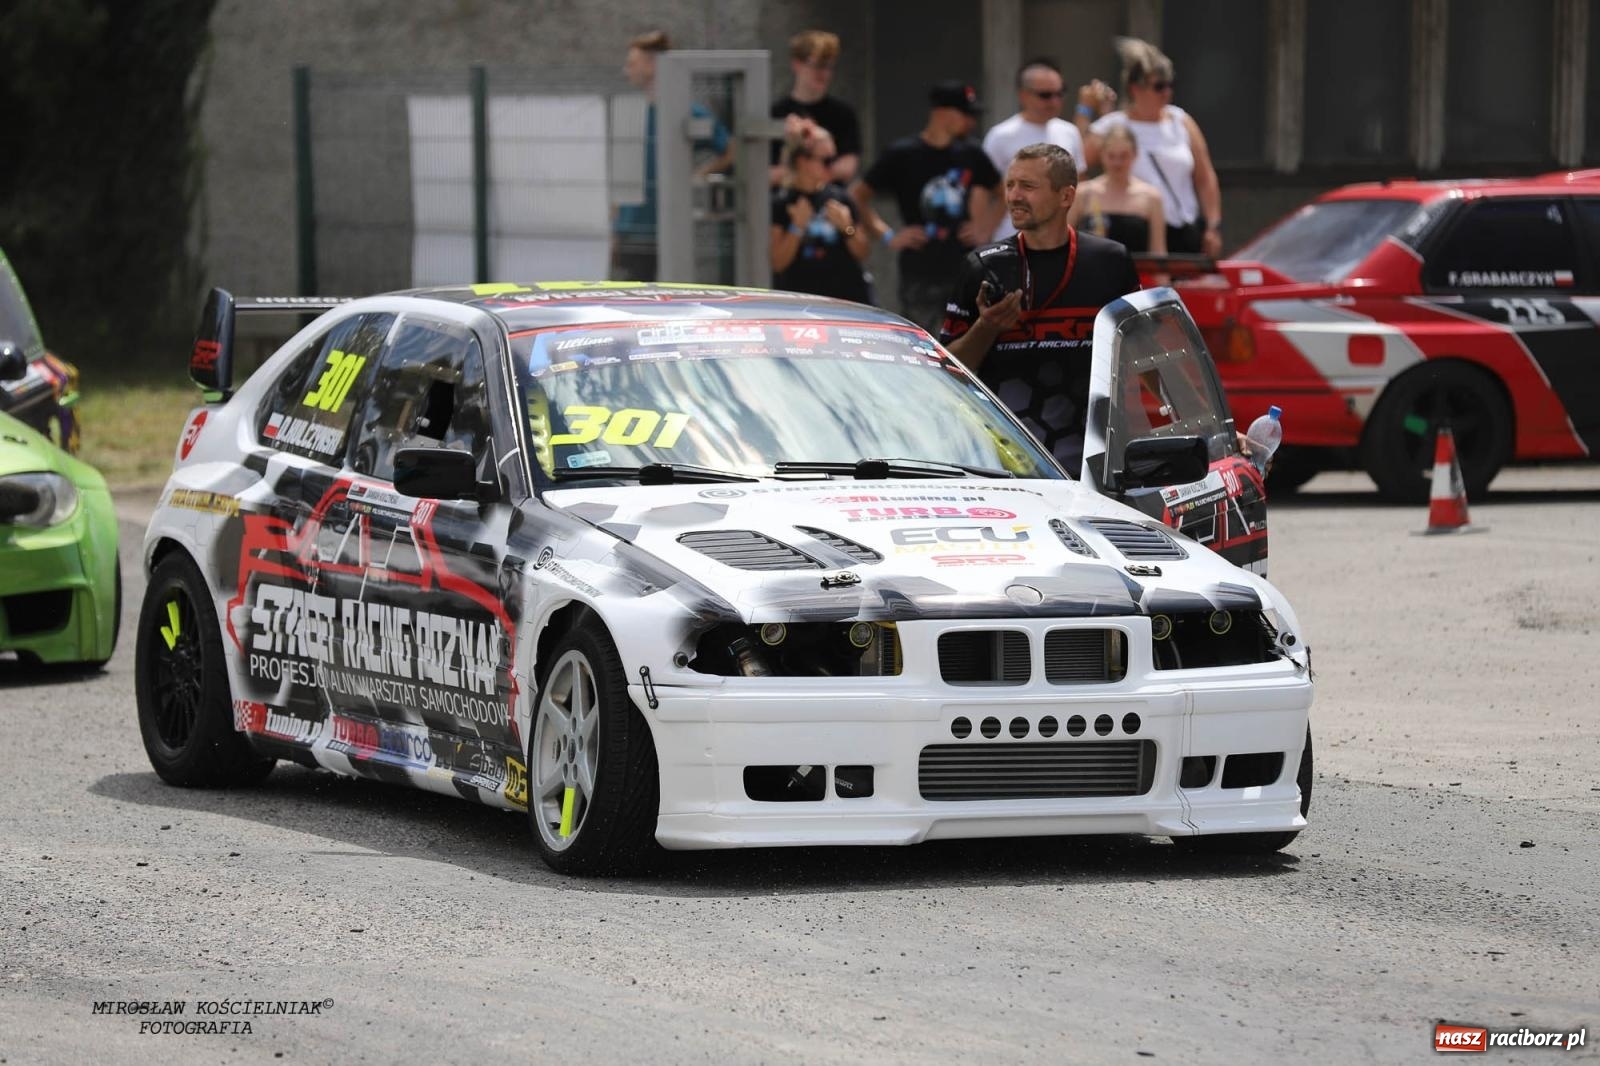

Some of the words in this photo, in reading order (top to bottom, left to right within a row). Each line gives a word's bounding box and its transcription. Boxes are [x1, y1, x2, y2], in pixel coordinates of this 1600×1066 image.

[1490, 297, 1566, 326] 225
[791, 327, 820, 340] 74
[1038, 340, 1079, 349] RACING
[303, 349, 366, 413] 301
[549, 405, 690, 449] 301
[1222, 469, 1240, 497] 301
[411, 501, 436, 526] 301
[890, 525, 1032, 546] ECU
[251, 583, 336, 665] STREET
[341, 599, 412, 679] RACING
[357, 676, 417, 708] WARSZTAT
